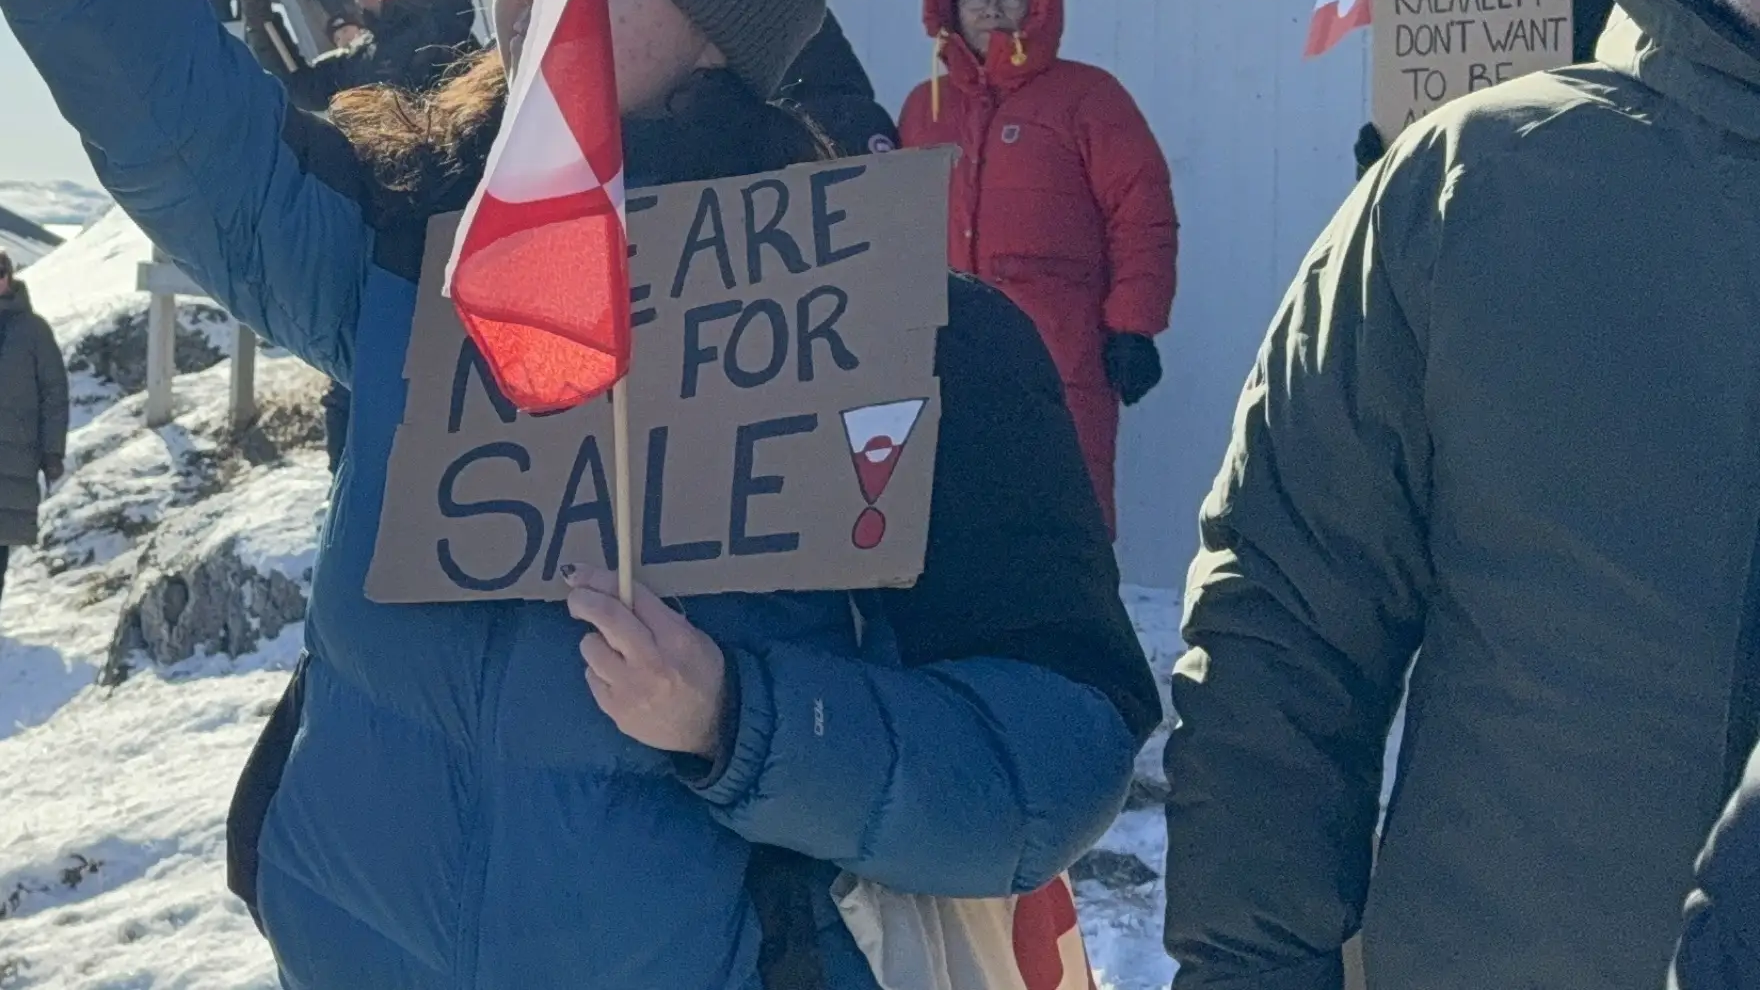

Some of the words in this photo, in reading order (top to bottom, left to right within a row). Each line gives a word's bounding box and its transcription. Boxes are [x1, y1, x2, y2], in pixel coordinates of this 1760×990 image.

[1396, 19, 1475, 57] DON'T
[1482, 17, 1567, 53] WANT
[1401, 67, 1447, 101] TO
[670, 164, 871, 299] ARE
[680, 285, 860, 399] FOR
